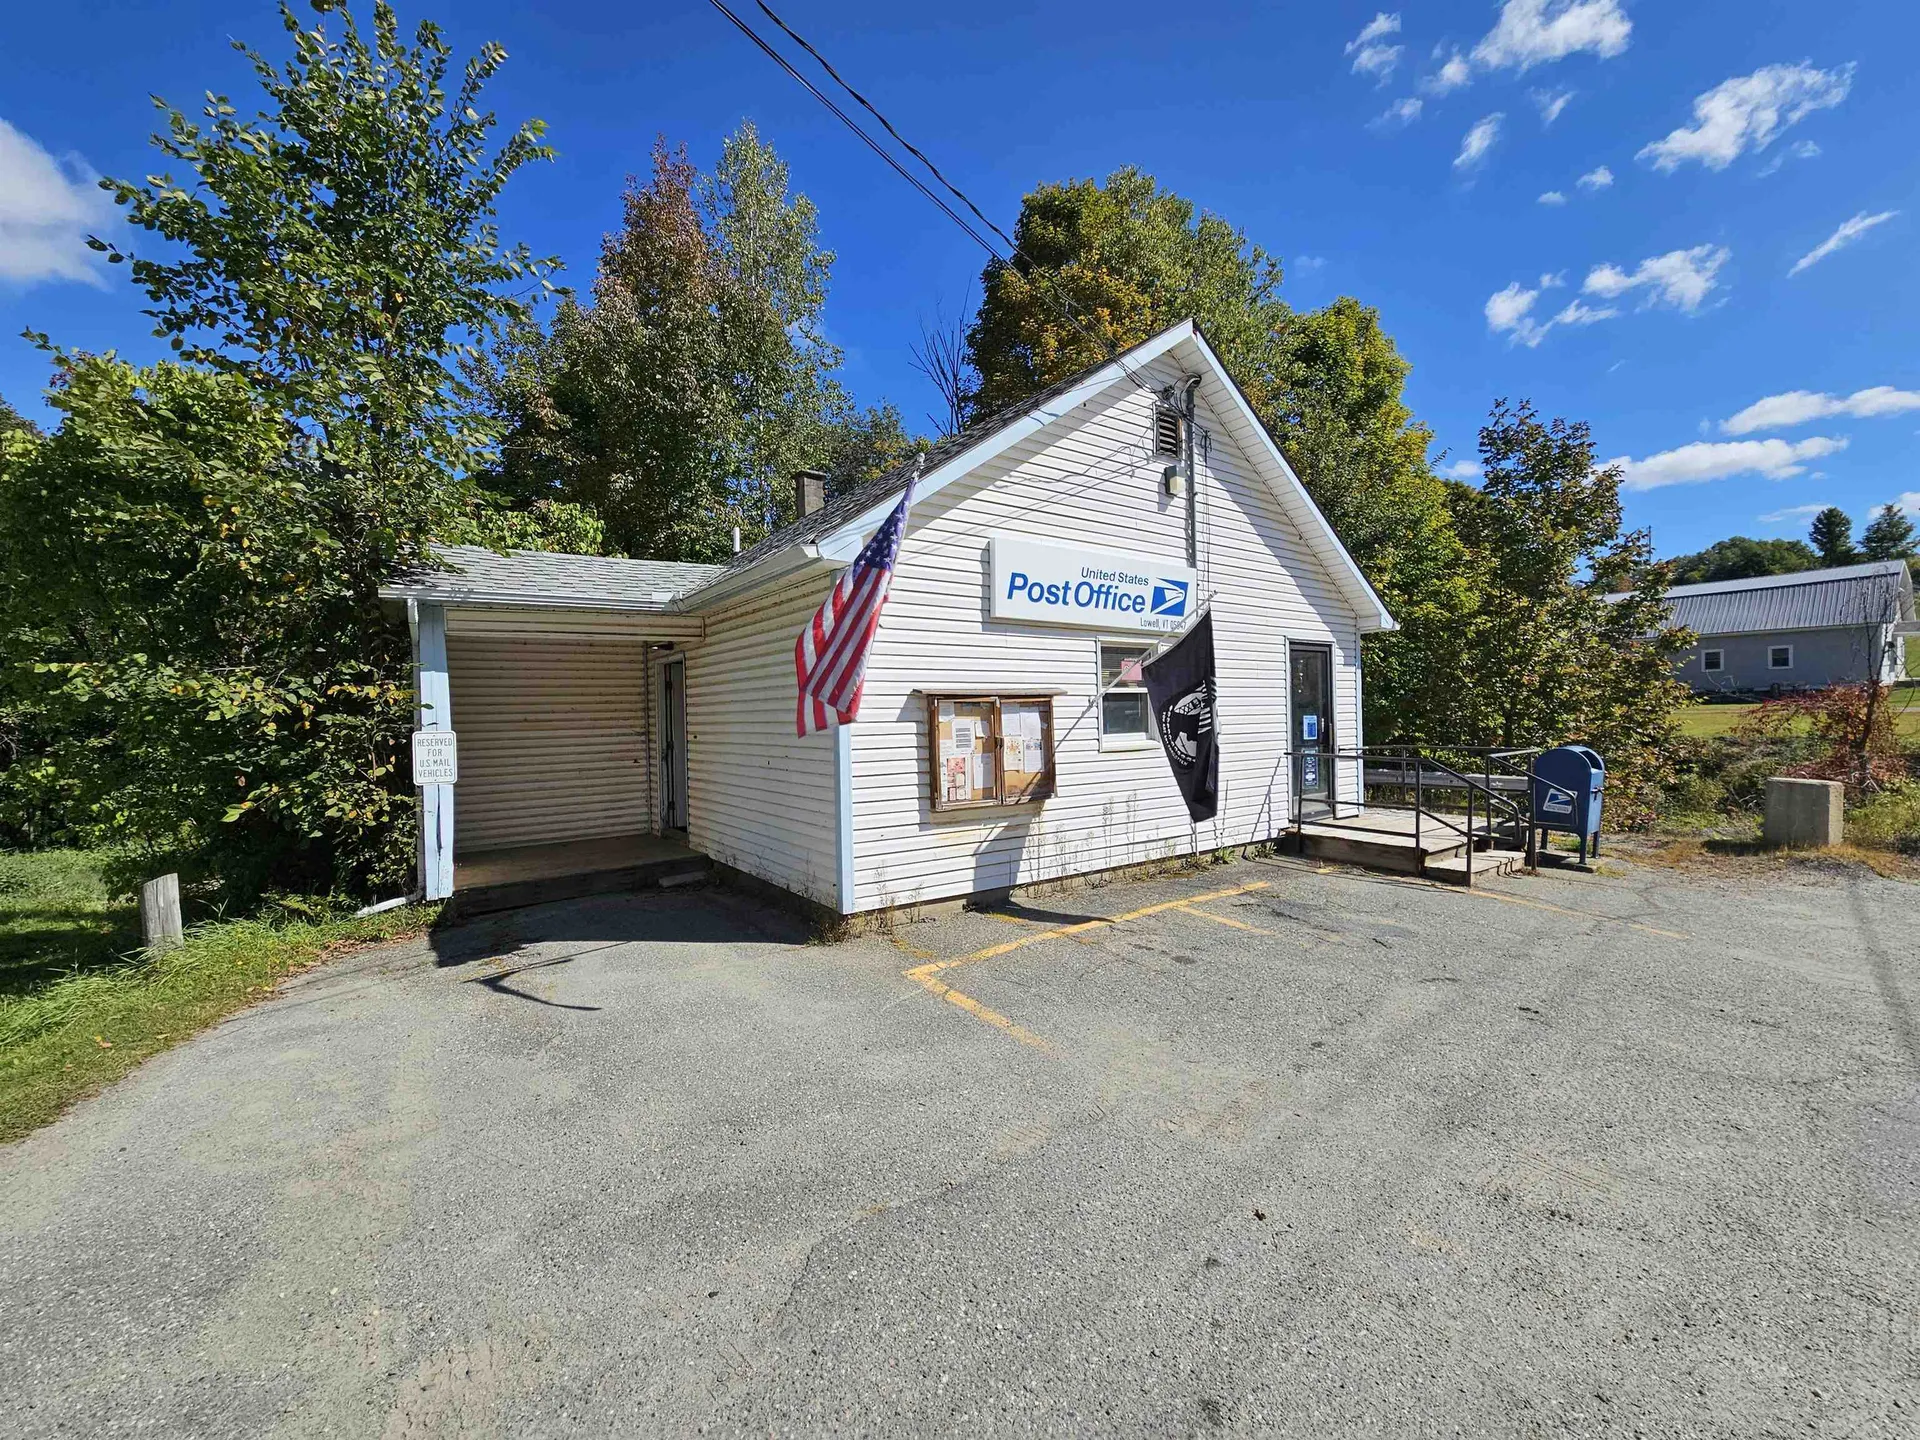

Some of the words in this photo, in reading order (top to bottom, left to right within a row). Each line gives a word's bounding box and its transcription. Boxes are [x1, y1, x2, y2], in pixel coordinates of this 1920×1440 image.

[1081, 567, 1116, 581] United
[1117, 573, 1149, 586] States
[1007, 572, 1071, 606] Post
[1074, 581, 1146, 613] Office
[1140, 617, 1161, 629] Lowell,
[417, 738, 452, 746] RESERVED
[428, 748, 442, 756] FOR
[433, 758, 450, 766] MAIL
[418, 768, 453, 778] VEHICLES
